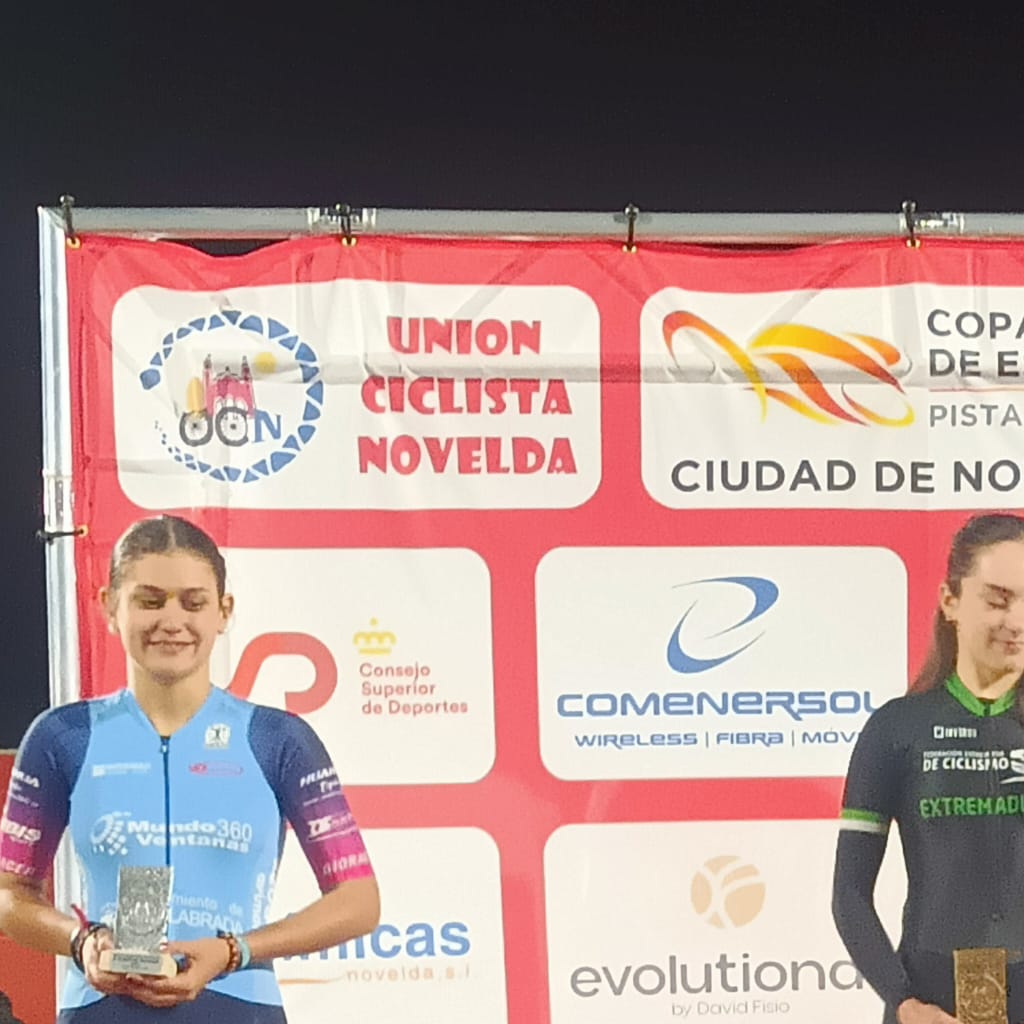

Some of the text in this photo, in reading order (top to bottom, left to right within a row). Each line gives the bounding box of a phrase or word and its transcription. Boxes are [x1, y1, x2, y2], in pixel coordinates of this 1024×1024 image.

[387, 316, 542, 356] UNION
[929, 349, 980, 378] DE
[361, 375, 572, 415] CICLISTA
[929, 403, 1023, 428] PISTA
[357, 436, 578, 475] NOVELDA
[670, 459, 858, 493] CIUDAD
[875, 461, 936, 493] DE
[359, 661, 431, 682] Consejo
[361, 680, 436, 698] Superior
[361, 700, 468, 717] de Deportes
[802, 727, 861, 746] MÓV
[922, 759, 940, 772] DE
[217, 818, 253, 842] 360
[167, 908, 244, 935] LABRADA
[671, 1000, 791, 1018] by David Fisio
